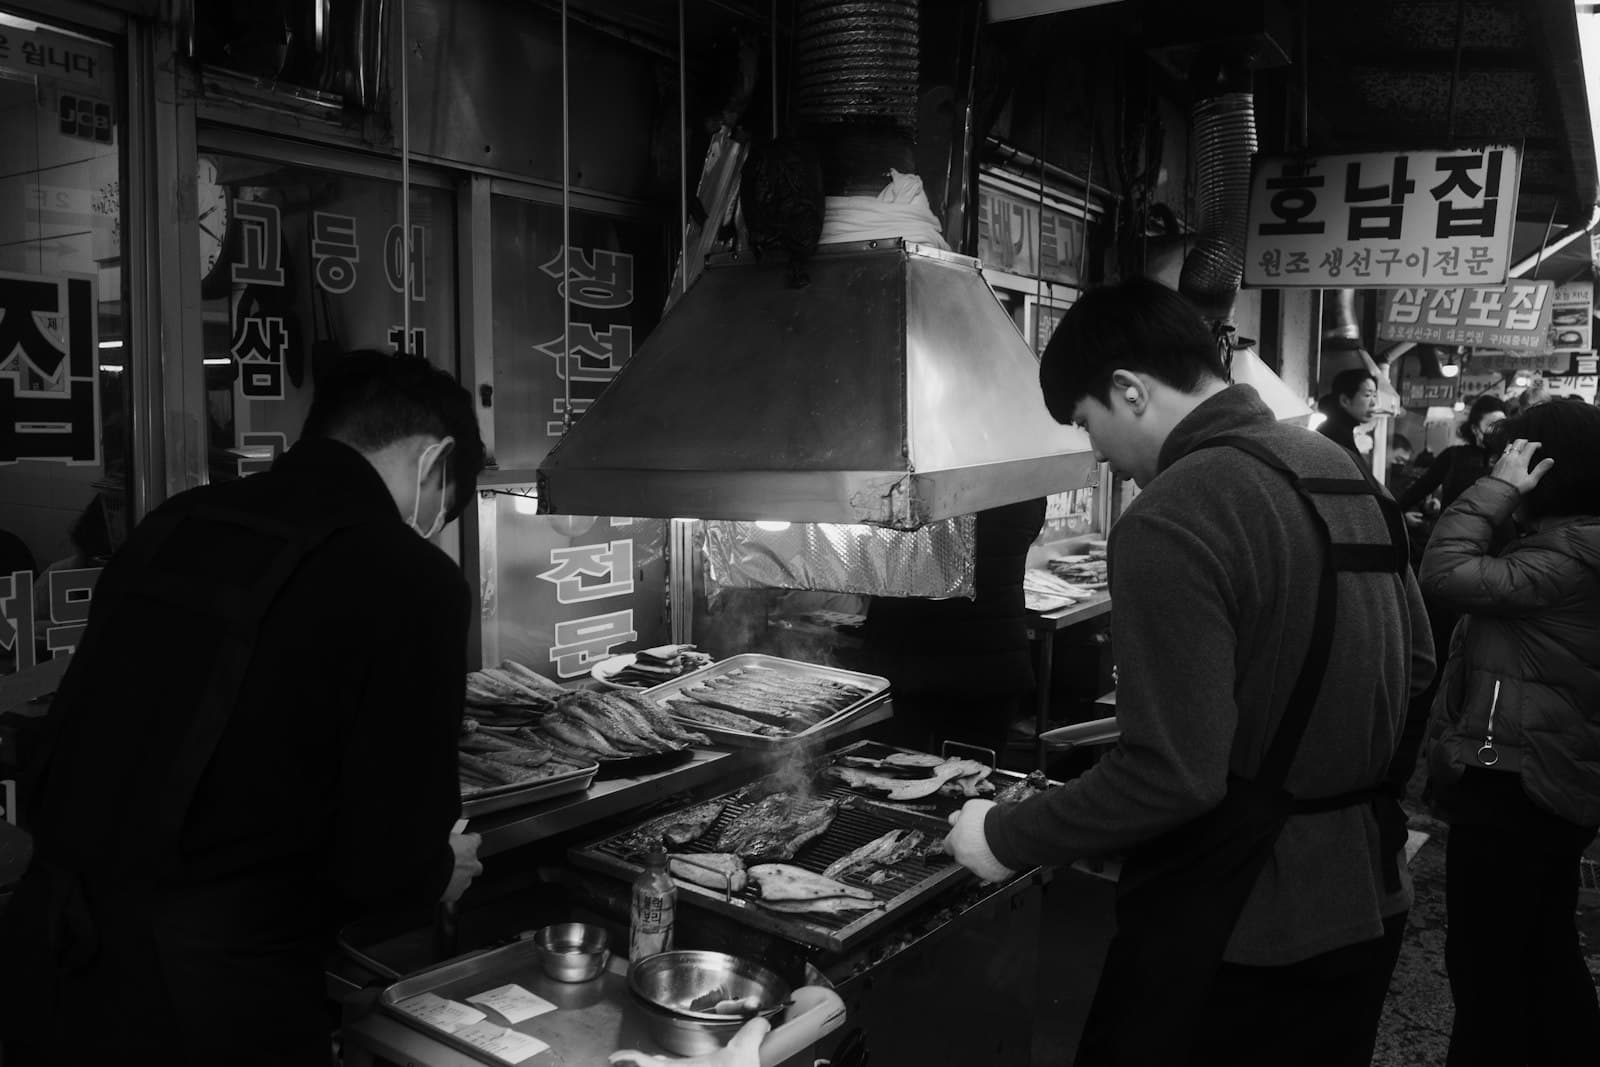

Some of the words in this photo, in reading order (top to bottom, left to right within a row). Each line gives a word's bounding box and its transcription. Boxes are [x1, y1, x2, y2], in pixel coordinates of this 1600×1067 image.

[22, 41, 97, 78] 쉽니다
[1258, 151, 1503, 241] 호남집
[1258, 249, 1310, 277] 원조
[1319, 246, 1494, 277] 생선구이전문
